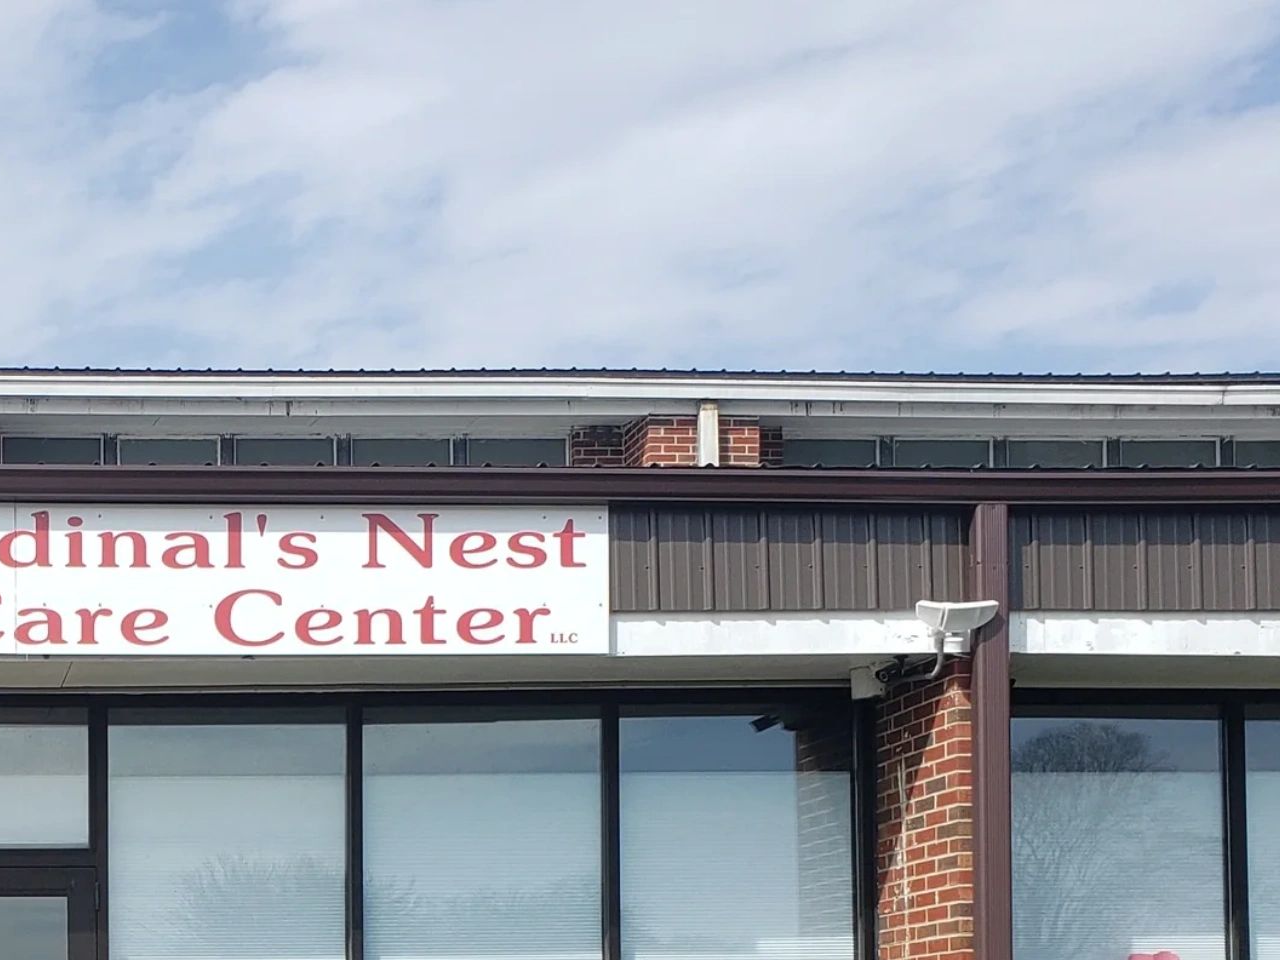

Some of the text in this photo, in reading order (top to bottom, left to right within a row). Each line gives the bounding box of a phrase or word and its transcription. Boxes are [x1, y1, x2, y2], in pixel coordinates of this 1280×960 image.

[361, 513, 587, 569] Nest
[213, 588, 551, 647] Center
[550, 632, 578, 644] LLC
